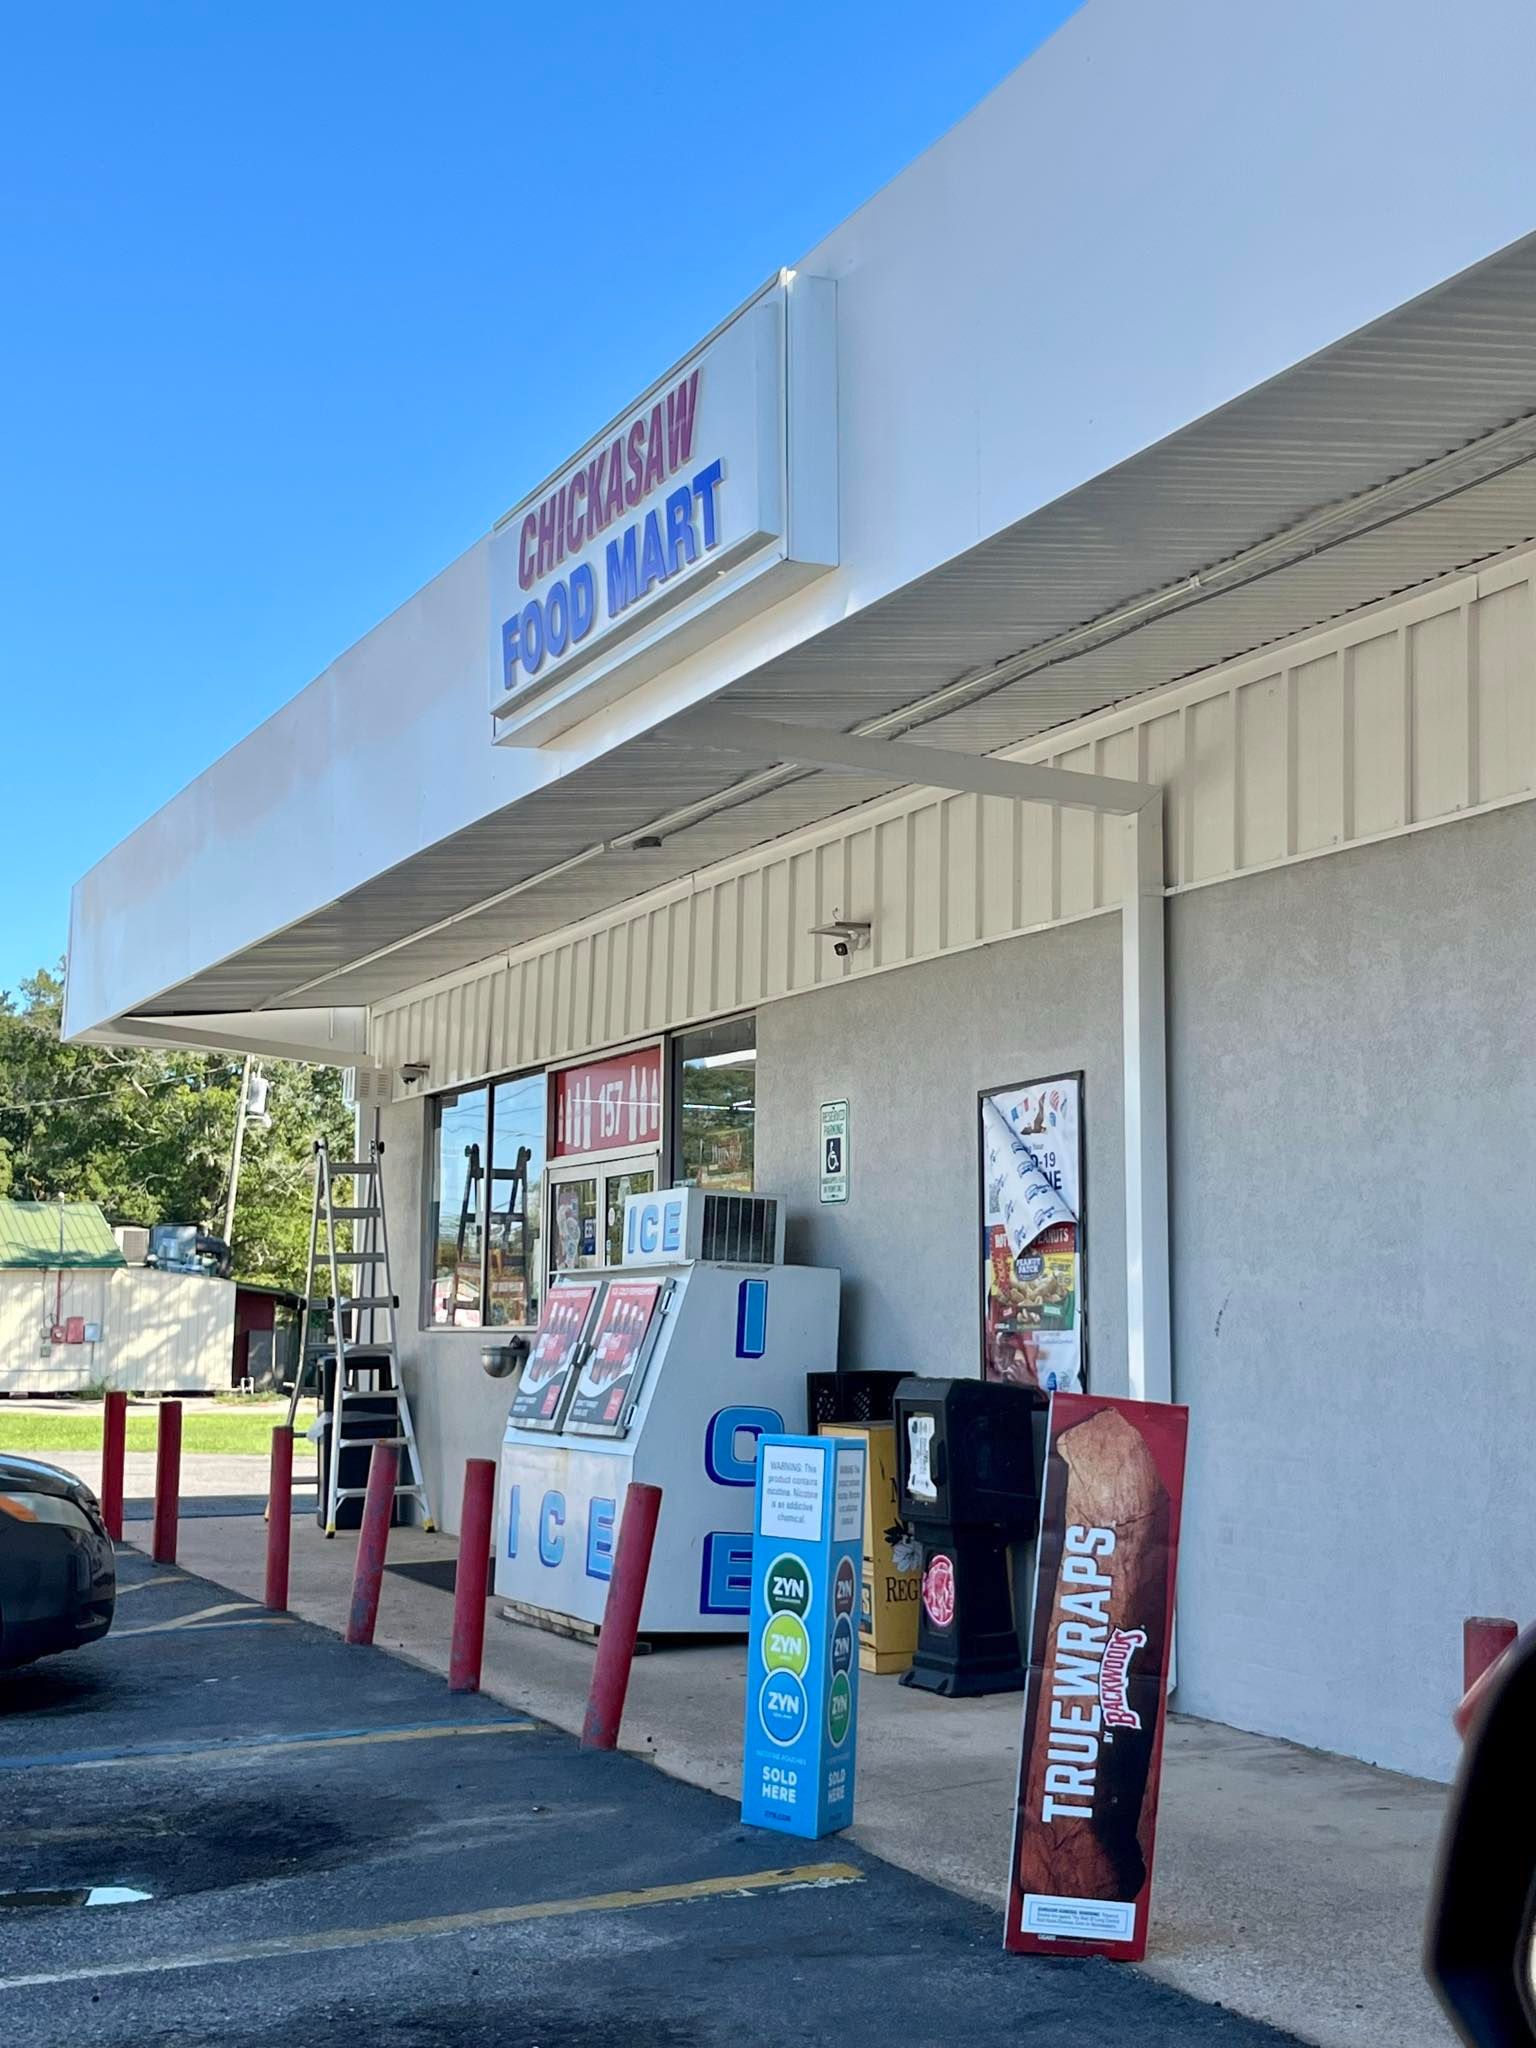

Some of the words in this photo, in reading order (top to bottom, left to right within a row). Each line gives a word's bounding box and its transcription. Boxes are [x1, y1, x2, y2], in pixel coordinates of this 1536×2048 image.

[518, 368, 700, 591] CHICKASAW
[502, 563, 594, 690] FOOD
[605, 458, 725, 618] MART
[627, 1201, 682, 1254] ICE
[508, 1484, 616, 1582] ICE
[773, 1576, 804, 1599] ZYN
[837, 1580, 852, 1600] ZYN
[770, 1634, 802, 1656] ZYN
[834, 1636, 850, 1657] ZYN
[1100, 1628, 1146, 1729] BACKWOODS
[768, 1691, 800, 1715] ZYN
[832, 1694, 848, 1715] ZYN
[1103, 1731, 1114, 1744] BY
[762, 1765, 797, 1786] SOLD
[828, 1768, 846, 1788] SOLD
[762, 1782, 797, 1804] HERE
[828, 1784, 845, 1804] HERE
